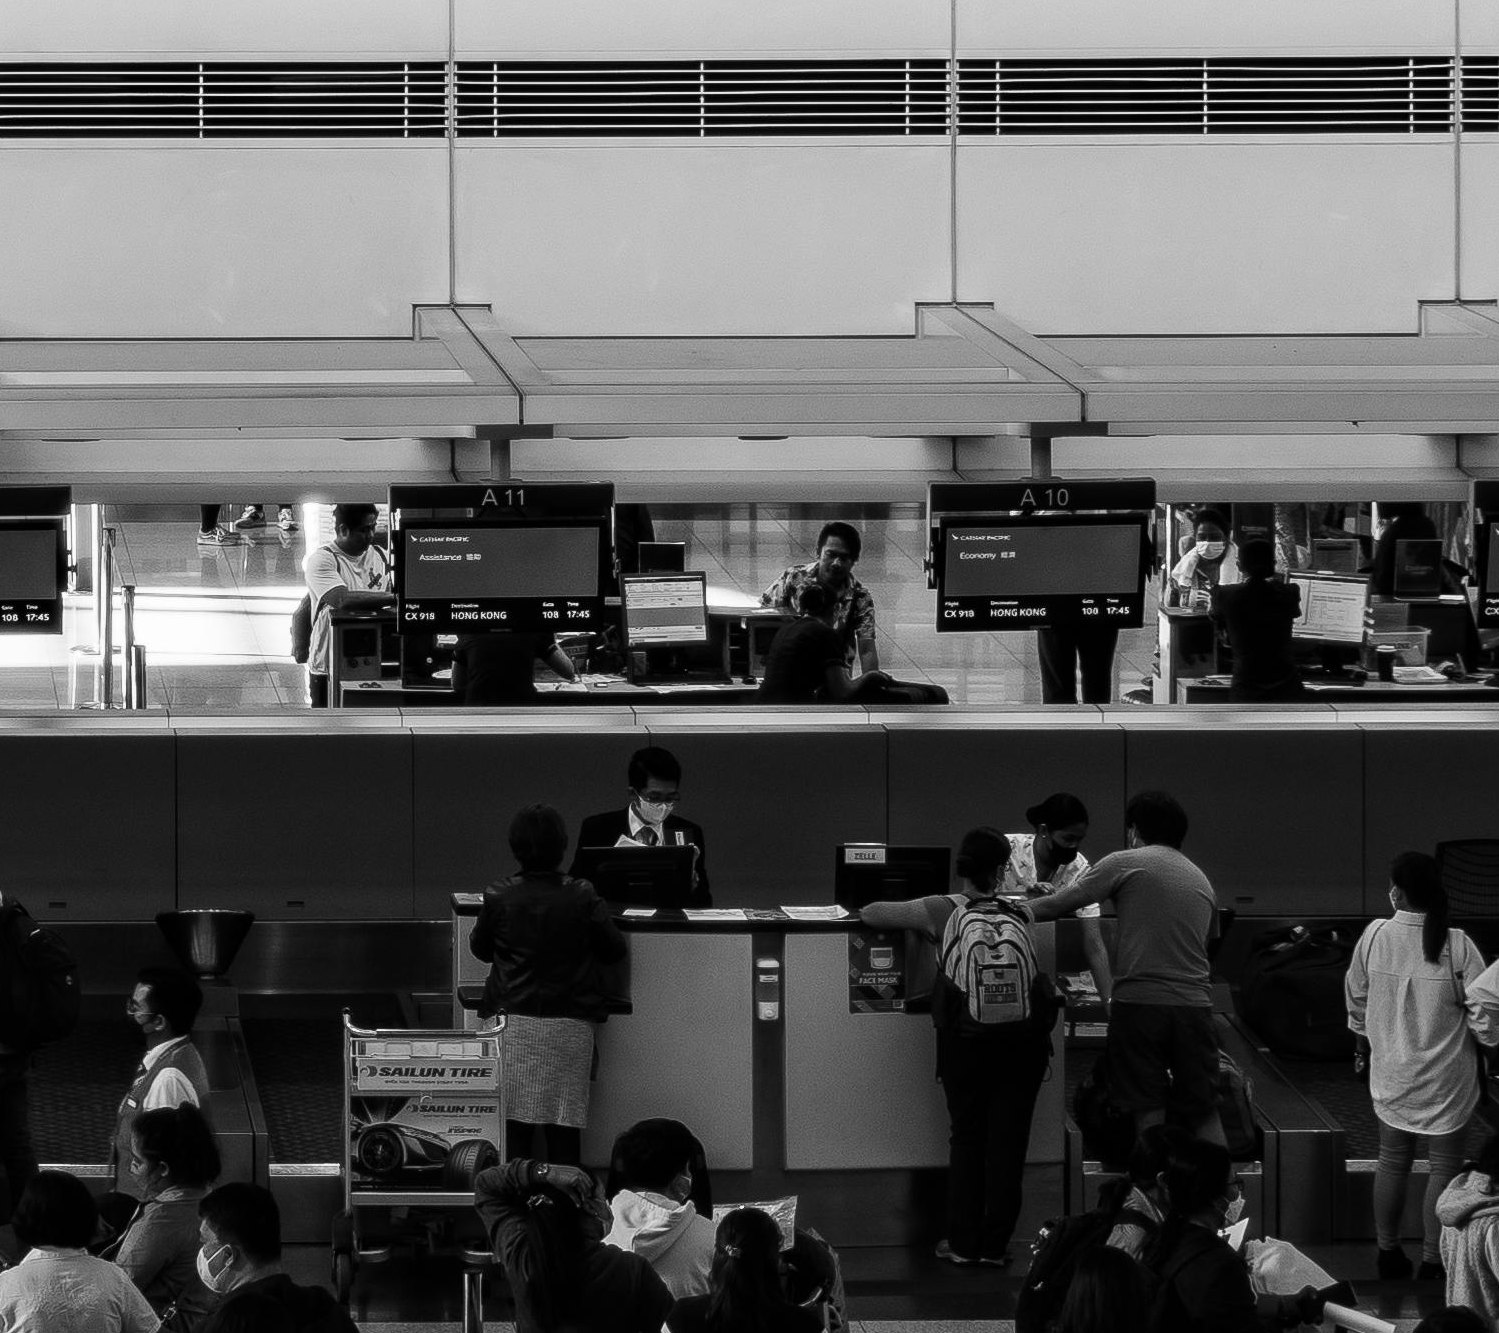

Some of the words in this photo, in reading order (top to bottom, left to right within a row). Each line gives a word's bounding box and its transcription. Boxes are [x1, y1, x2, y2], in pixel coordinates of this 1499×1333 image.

[482, 488, 498, 506] A
[505, 488, 525, 506] 11
[1020, 488, 1036, 506] A
[1045, 488, 1069, 506] 10
[419, 553, 462, 561] Assistance
[959, 552, 997, 560] Economy
[405, 611, 418, 620] CX
[419, 611, 435, 620] 918
[451, 611, 479, 620] HONG
[480, 611, 507, 619] KONG
[566, 610, 590, 618] 17:45
[944, 610, 957, 618] CX
[990, 608, 1018, 617] HONG
[1019, 608, 1047, 616] KONG
[1106, 607, 1130, 615] 17:45
[1485, 607, 1499, 615] CX
[1, 614, 19, 622] 108
[25, 613, 50, 622] 17:45
[854, 852, 877, 861] ZELLE
[878, 976, 898, 985] MASK
[378, 1067, 446, 1078] SAILUN
[450, 1067, 493, 1078] TIRE
[419, 1105, 465, 1114] SAILUN
[467, 1105, 498, 1114] TIRE
